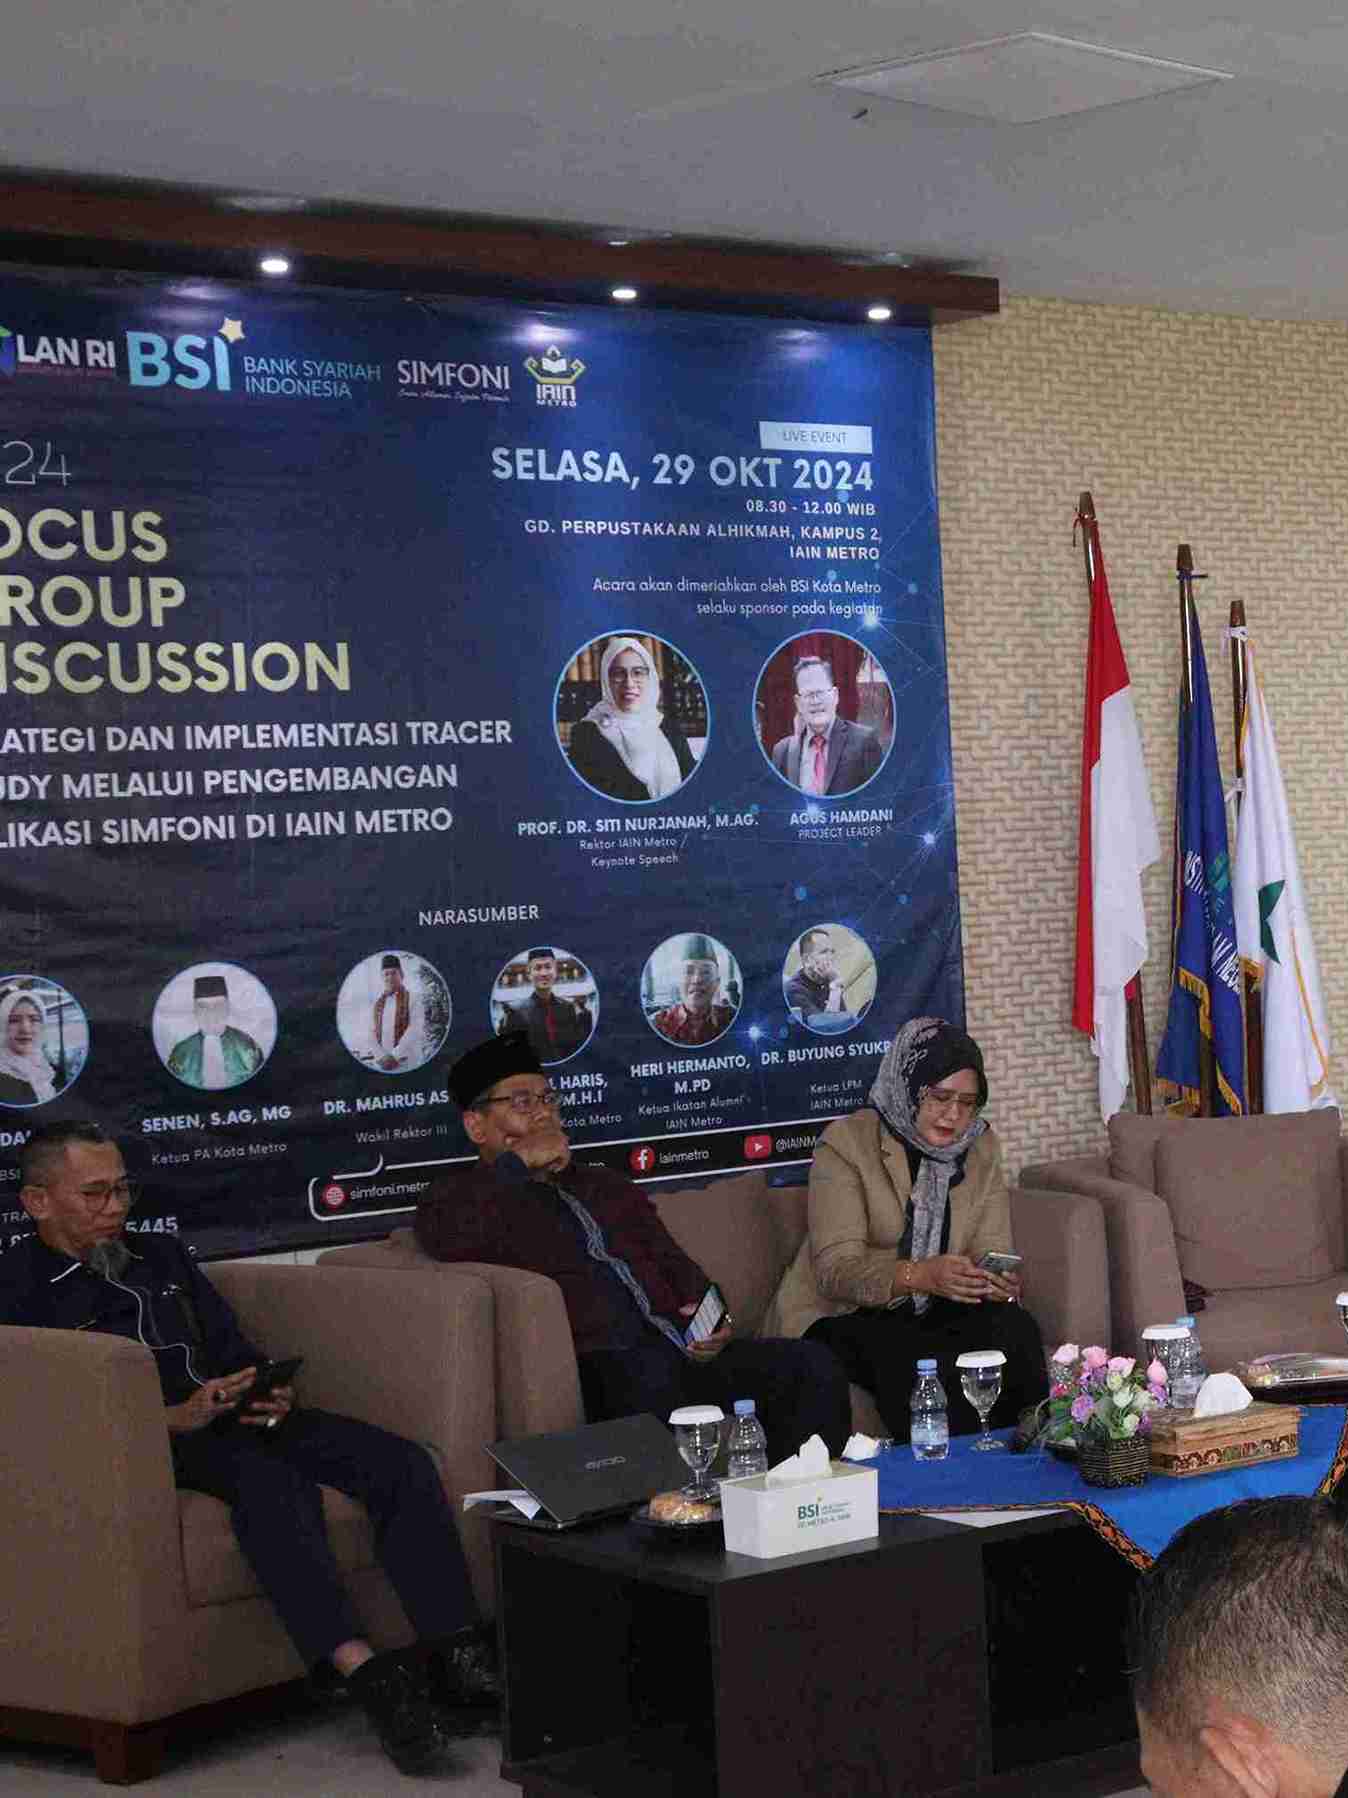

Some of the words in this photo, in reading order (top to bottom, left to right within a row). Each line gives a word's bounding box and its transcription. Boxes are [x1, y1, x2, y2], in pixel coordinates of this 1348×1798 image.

[17, 334, 79, 366] LAN
[86, 339, 116, 368] RI
[126, 331, 231, 391] BSI
[243, 356, 298, 375] BANK
[303, 360, 381, 381] SYARIAH
[397, 359, 510, 389] SIMFONI
[245, 375, 352, 399] INDONESIA
[783, 431, 808, 442] LIVE
[812, 431, 848, 444] EVENT
[492, 447, 640, 490] SELASA,
[652, 453, 695, 485] 29
[710, 456, 782, 488] OKT
[792, 459, 873, 491] 2024
[746, 500, 786, 513] 08.30
[803, 501, 841, 515] 12.00
[847, 503, 876, 516] WIB
[524, 519, 555, 533] GD.
[562, 520, 700, 536] PERPUSTAKAAN
[706, 524, 795, 540] ALHIKMAH,
[801, 526, 864, 540] KAMPUS
[790, 546, 821, 559] IAIN
[826, 547, 880, 560] METRO
[592, 577, 635, 592] Acara
[640, 576, 673, 591] akan
[677, 576, 756, 592] dimeriahkan
[760, 577, 786, 592] oleh
[790, 579, 809, 592] BSI
[813, 580, 841, 592] Kota
[845, 580, 881, 593] Metro
[697, 599, 736, 614] selaku
[740, 604, 787, 619] sponsor
[792, 600, 825, 619] pada
[106, 726, 174, 751] DAN
[185, 721, 398, 749] IMPLEMENTASI
[405, 720, 512, 745] TRACER
[62, 770, 193, 799] MELALUI
[204, 764, 458, 795] PENGEMBANGAN
[518, 821, 561, 835] PROF.
[567, 821, 591, 834] DR.
[625, 816, 711, 832] NURJANAH,
[830, 808, 893, 823] HAMDANI
[102, 814, 235, 845] SIMFONI
[246, 813, 275, 840] DI
[286, 810, 346, 837] IAIN
[355, 807, 452, 835] METRO
[644, 837, 677, 848] Metro
[418, 904, 539, 926] NARASUMBER
[761, 1052, 784, 1065] DR.
[788, 1046, 845, 1062] BUYUNG
[631, 1061, 663, 1077] HERI
[667, 1055, 750, 1074] HERMANTO,
[560, 1073, 608, 1089] HARIS,
[674, 1078, 711, 1094] M.PD
[323, 1100, 352, 1115] DR.
[356, 1092, 425, 1110] MAHRUS
[142, 1113, 205, 1133] SENEN,
[798, 1503, 819, 1520] BSI
